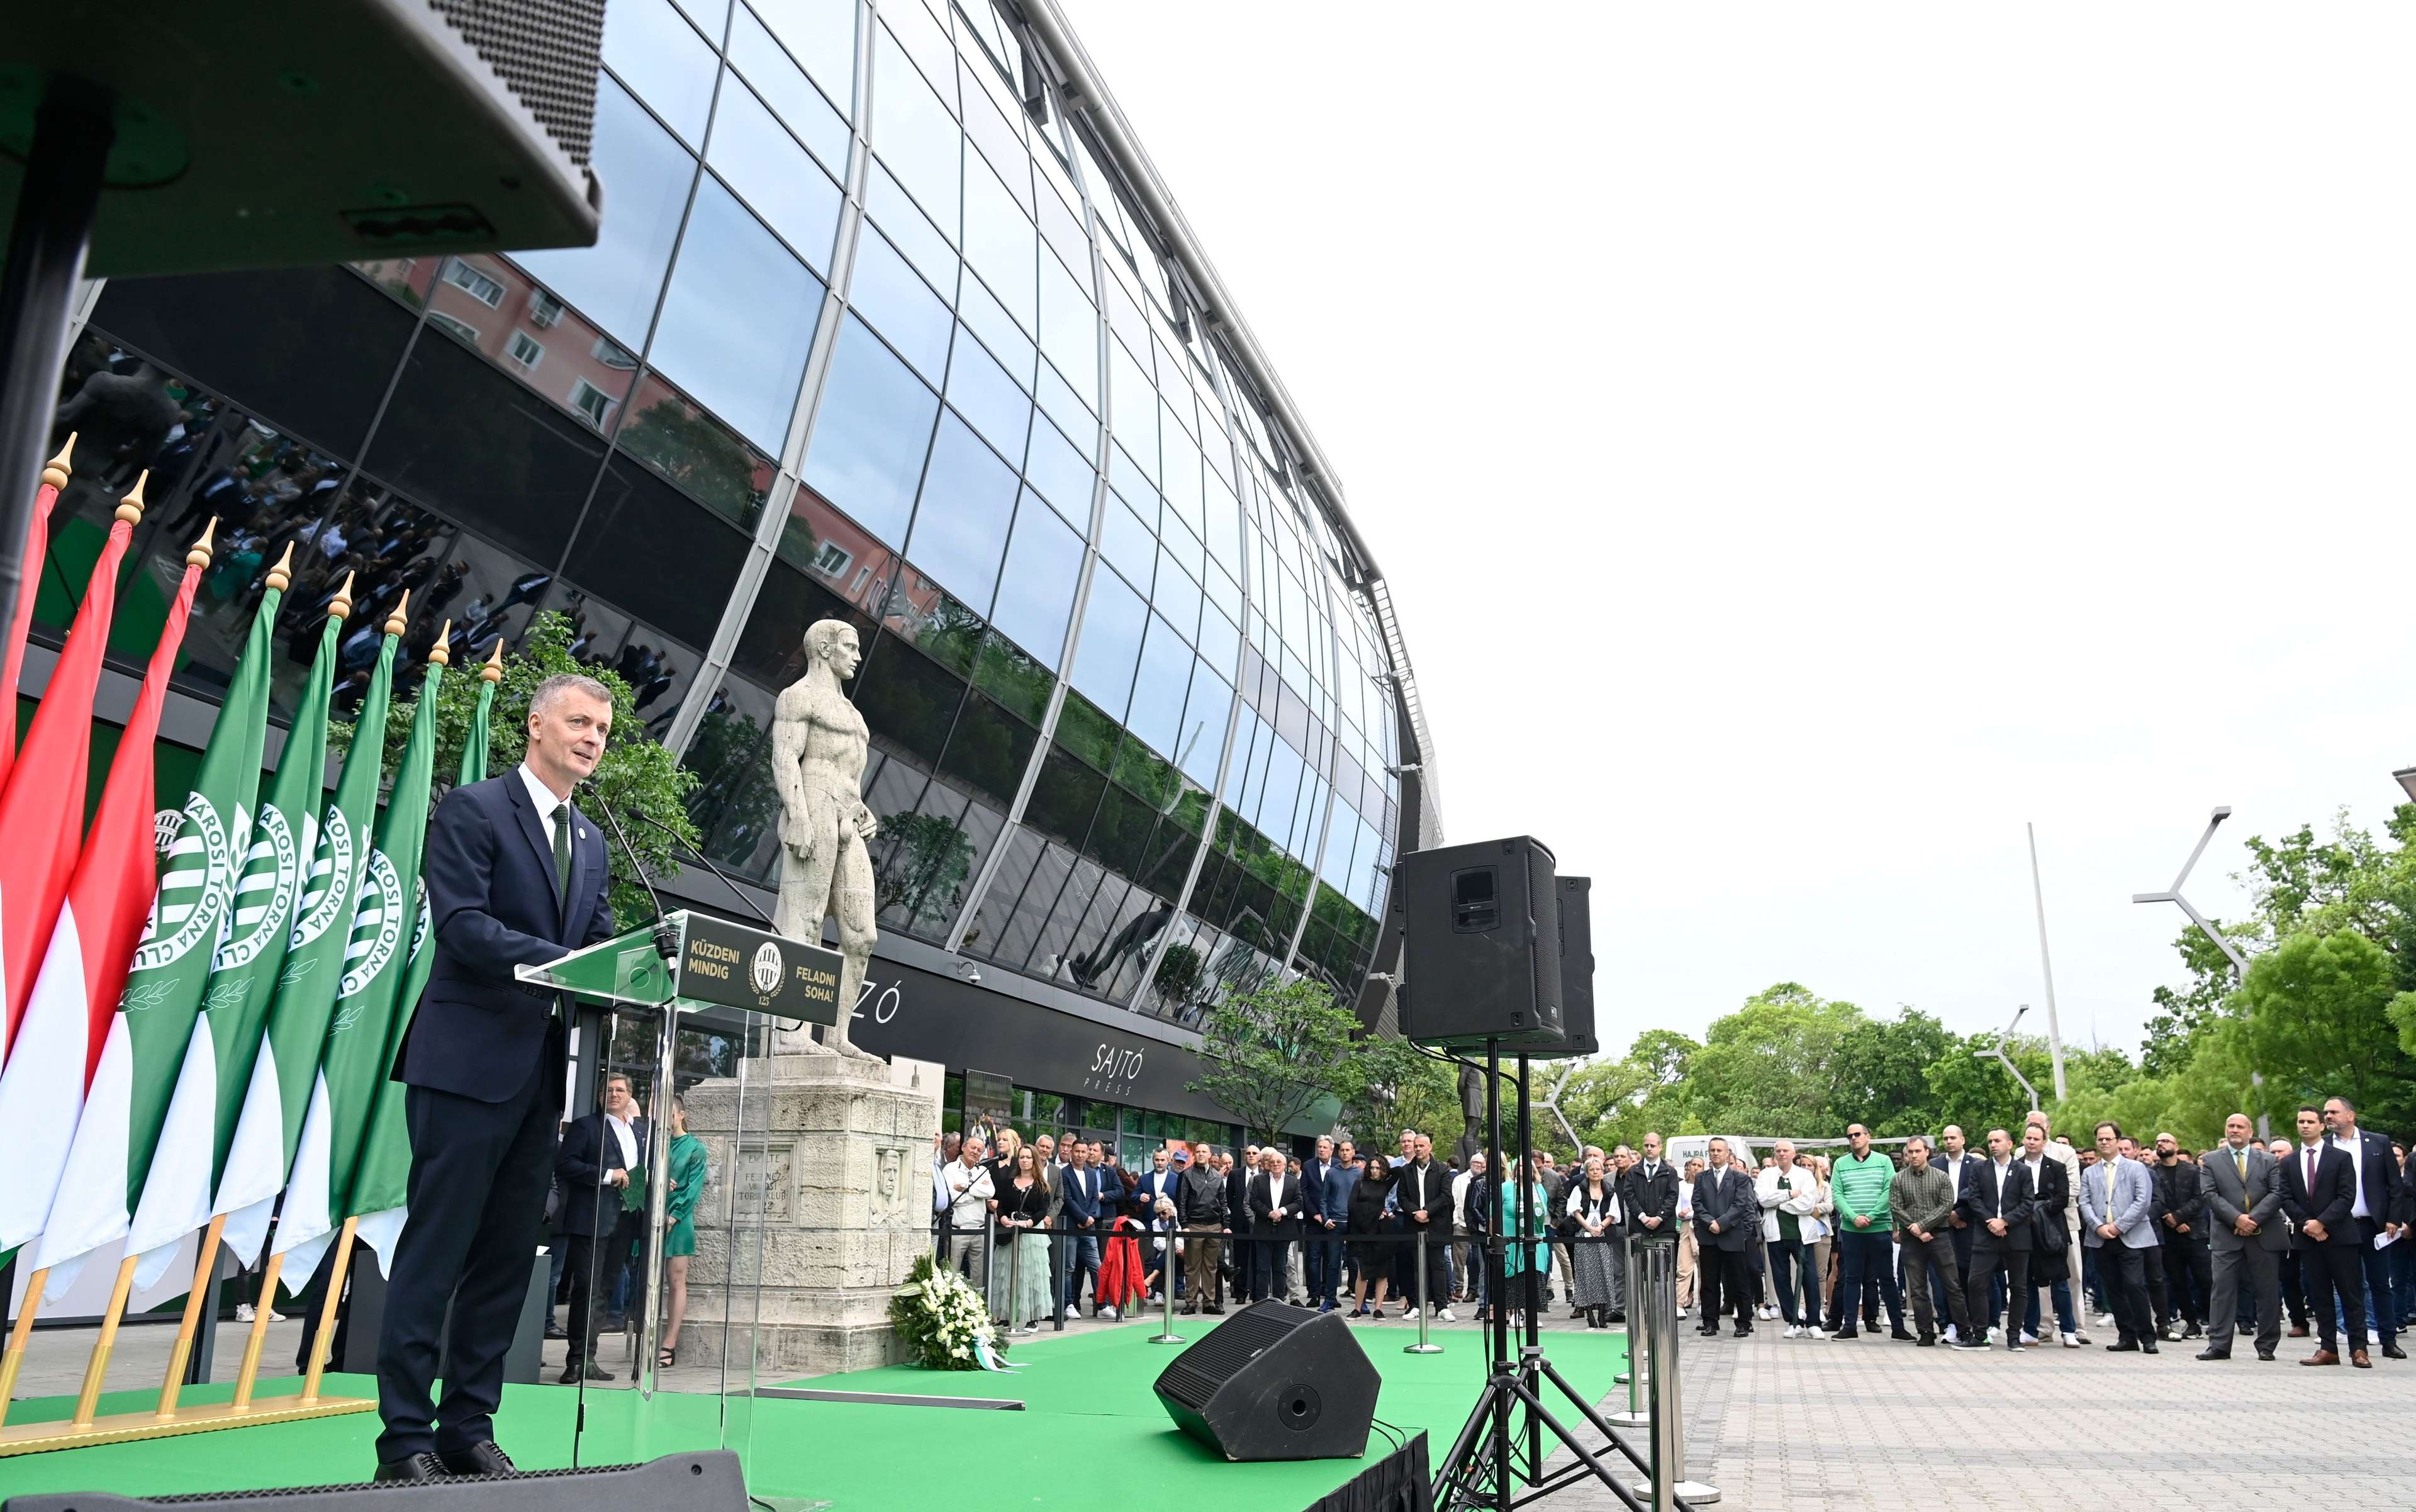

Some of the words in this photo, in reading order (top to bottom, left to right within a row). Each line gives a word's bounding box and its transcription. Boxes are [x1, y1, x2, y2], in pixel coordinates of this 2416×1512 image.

[308, 866, 349, 931] TORNA
[177, 879, 223, 948] TORNA
[254, 881, 293, 948] TORNA
[361, 916, 400, 978] TORNA
[691, 939, 740, 964] KÜZDENI
[688, 958, 729, 980] MINDIG
[796, 966, 836, 987] FELADNI
[758, 995, 770, 1006] 125
[805, 985, 834, 1003] SOHA!
[1092, 1043, 1144, 1080] SAJTÓ
[1083, 1077, 1131, 1096] PRESS
[746, 1173, 781, 1181] FENCZ
